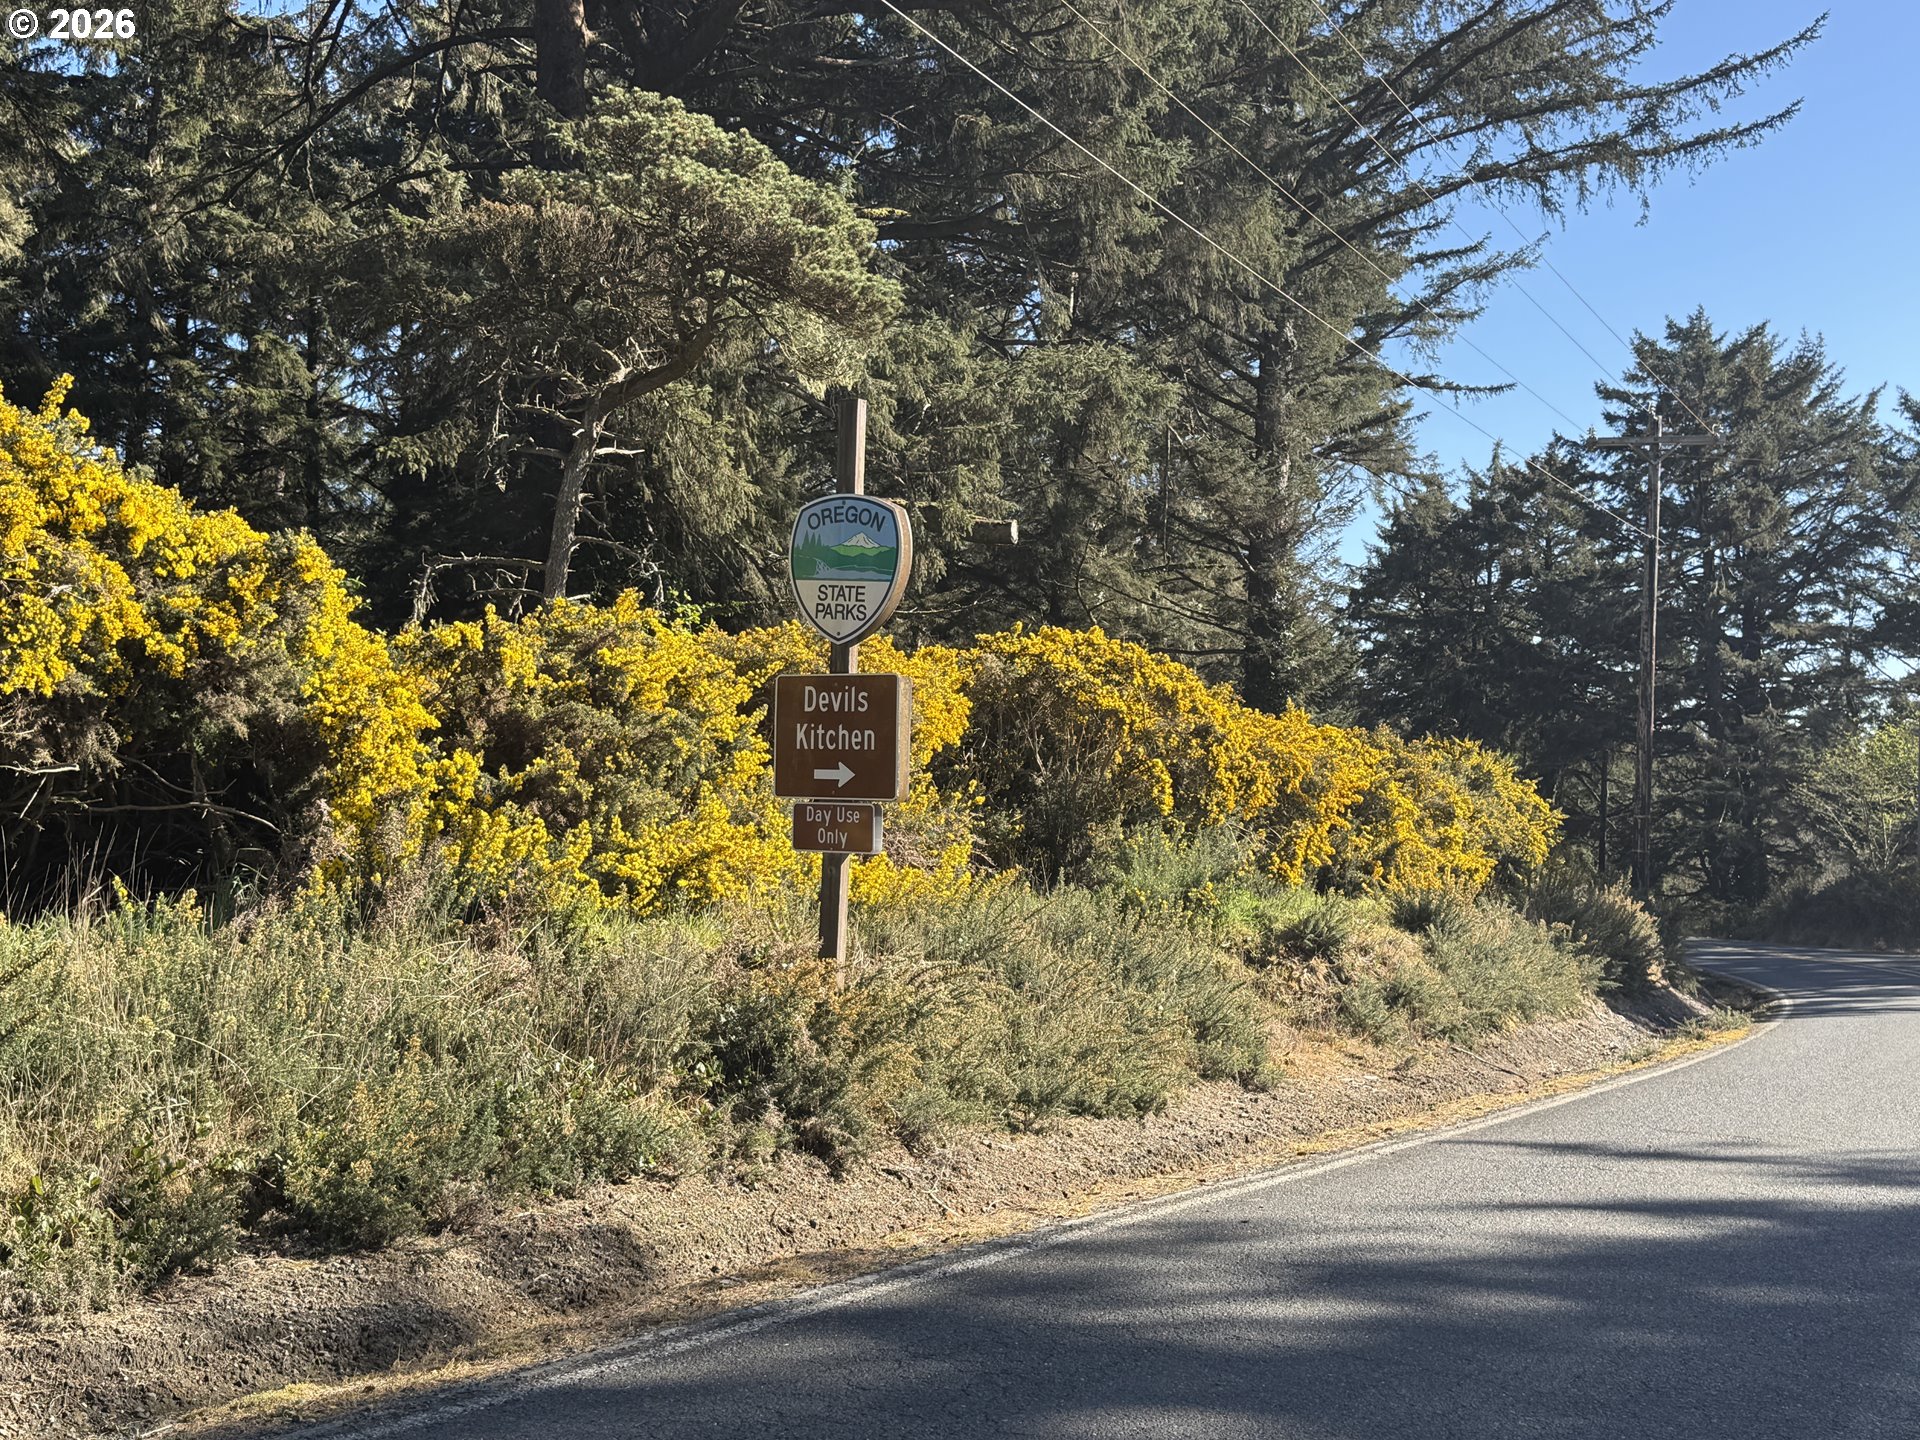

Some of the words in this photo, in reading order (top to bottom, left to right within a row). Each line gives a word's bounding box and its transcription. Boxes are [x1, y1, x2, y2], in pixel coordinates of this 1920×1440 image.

[807, 505, 886, 532] OREGON
[817, 584, 866, 602] STATE
[815, 602, 867, 621] PARKS
[804, 685, 869, 712] Devils
[796, 723, 875, 750] Kitchen
[806, 806, 832, 827] Day
[836, 806, 860, 823] Use
[817, 827, 848, 848] Only
